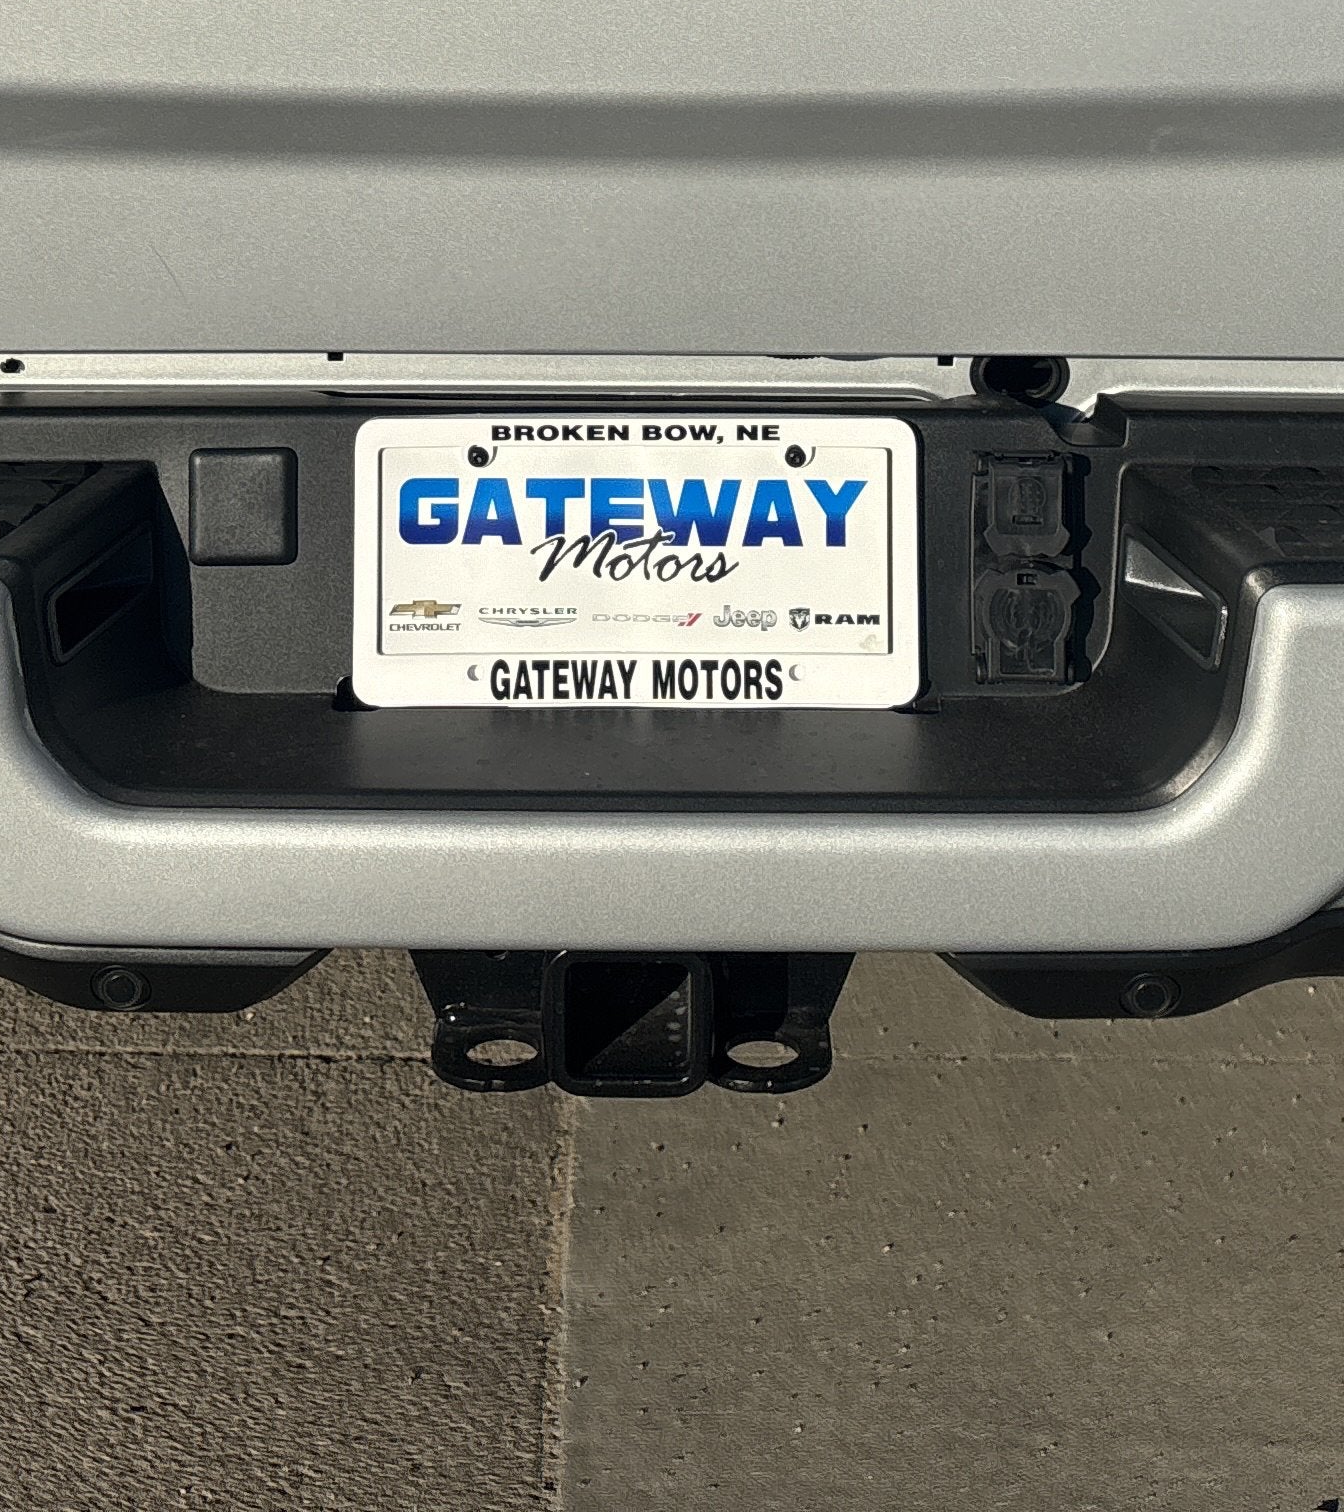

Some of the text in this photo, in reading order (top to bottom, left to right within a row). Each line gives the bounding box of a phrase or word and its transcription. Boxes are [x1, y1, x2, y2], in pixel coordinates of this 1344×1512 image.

[491, 424, 780, 444] BROKEN BOW, NE
[398, 477, 869, 547] GATEWAY
[530, 531, 740, 583] Motors
[478, 607, 578, 615] CHRYSLER
[591, 613, 692, 623] DODGE
[713, 604, 778, 631] Jeep
[814, 613, 881, 625] RAM
[389, 622, 462, 632] CHEVROLET
[490, 659, 784, 701] GATEWAY MOTORS
